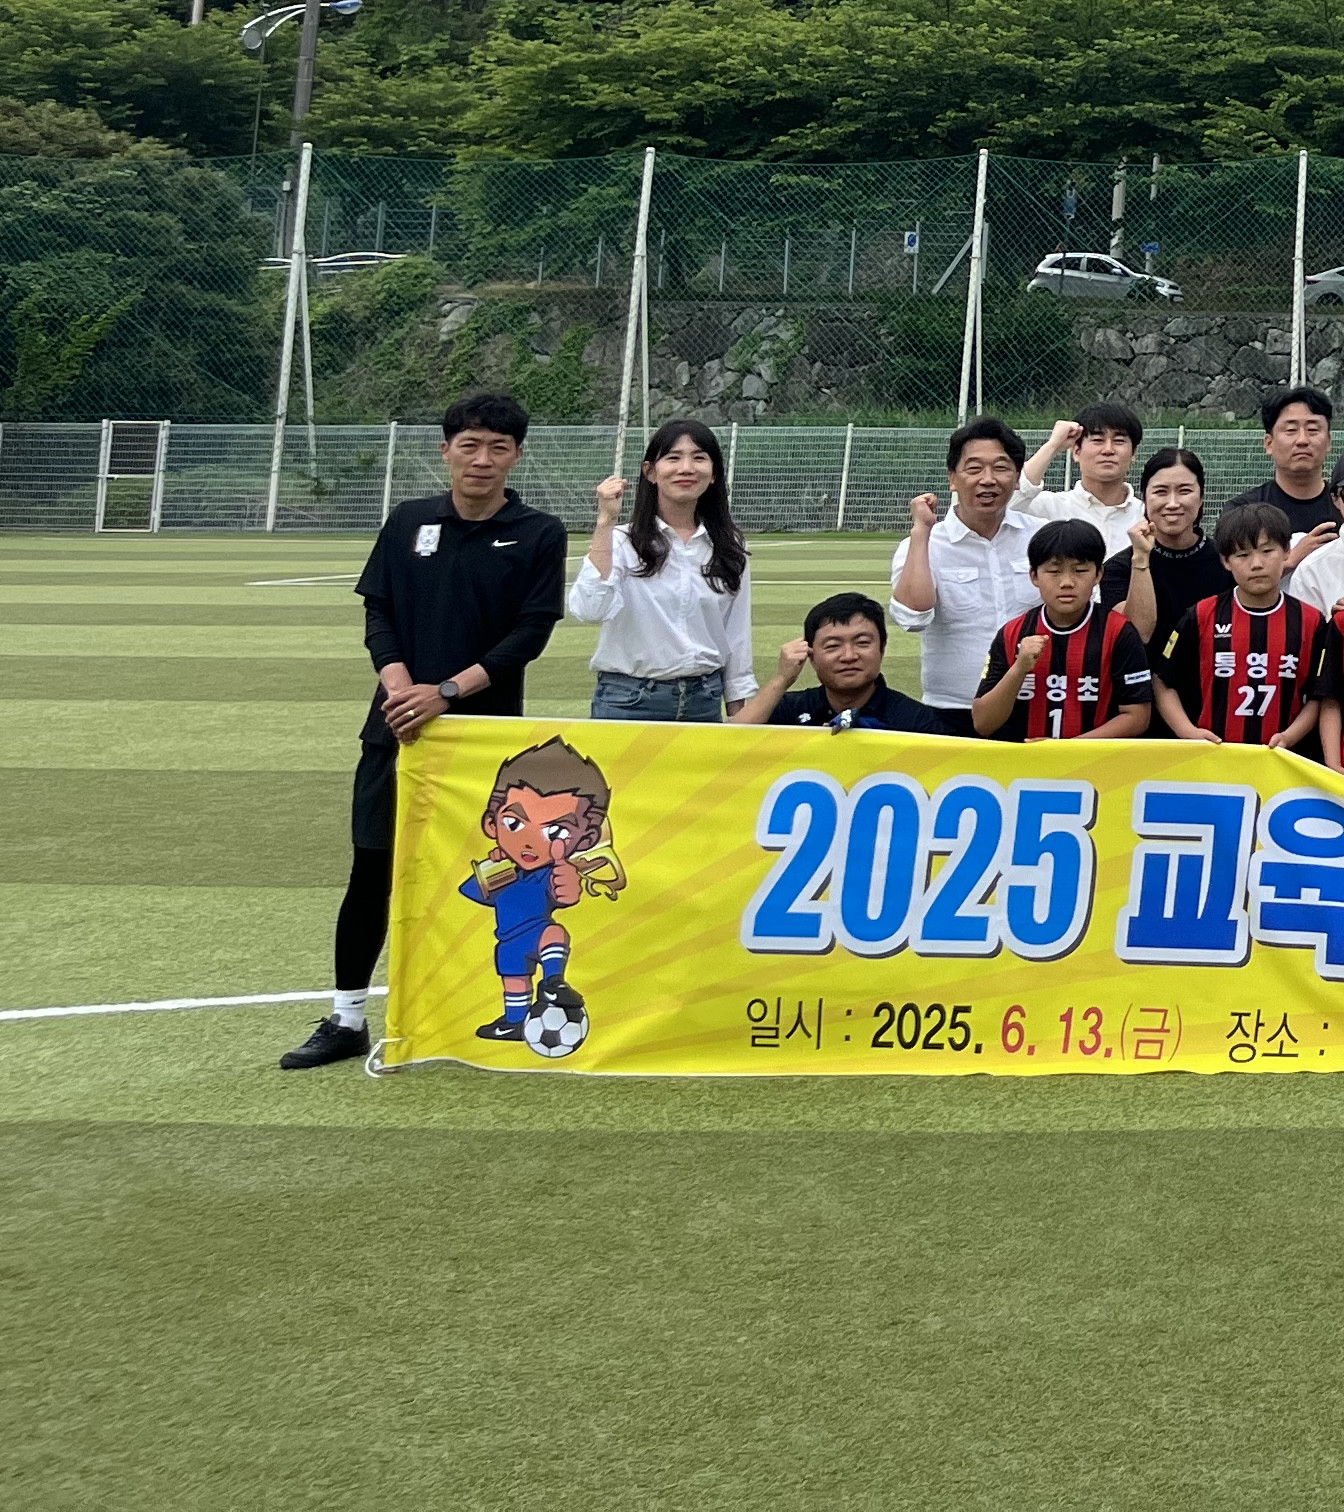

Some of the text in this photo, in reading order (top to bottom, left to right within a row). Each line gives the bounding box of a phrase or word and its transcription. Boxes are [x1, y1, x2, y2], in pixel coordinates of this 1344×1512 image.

[1214, 651, 1299, 679] 통영초
[1016, 673, 1099, 702] 통영초
[1234, 685, 1277, 717] 27
[1048, 708, 1063, 739] 1
[745, 773, 1092, 954] 2025
[746, 996, 823, 1050] 일시
[871, 1002, 983, 1055] 2025.
[1001, 1004, 1036, 1057] 6.
[1226, 1008, 1299, 1063] 장소
